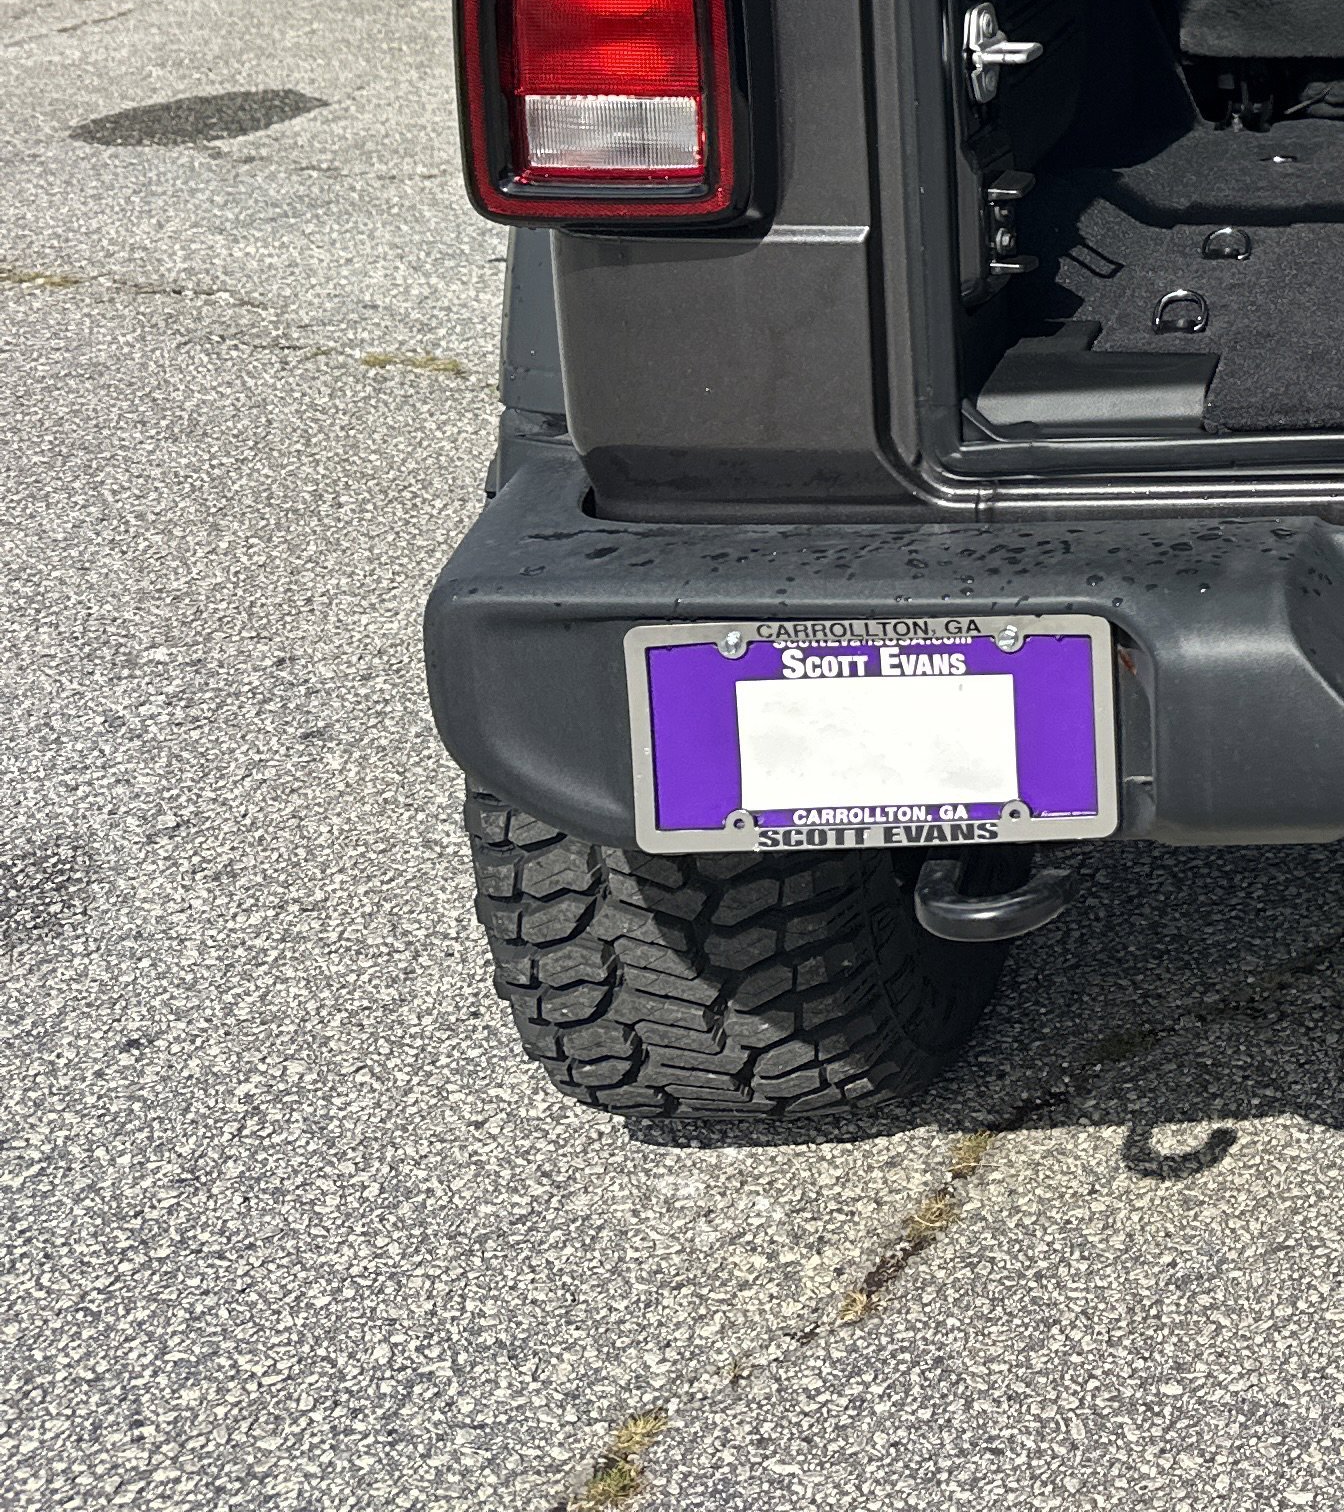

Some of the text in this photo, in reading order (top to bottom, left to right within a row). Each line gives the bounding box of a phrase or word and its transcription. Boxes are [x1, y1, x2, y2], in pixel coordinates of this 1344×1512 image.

[756, 619, 982, 639] CARROLLTON, GA
[939, 804, 968, 820] GA
[758, 822, 999, 848] SCOTT EVANS
